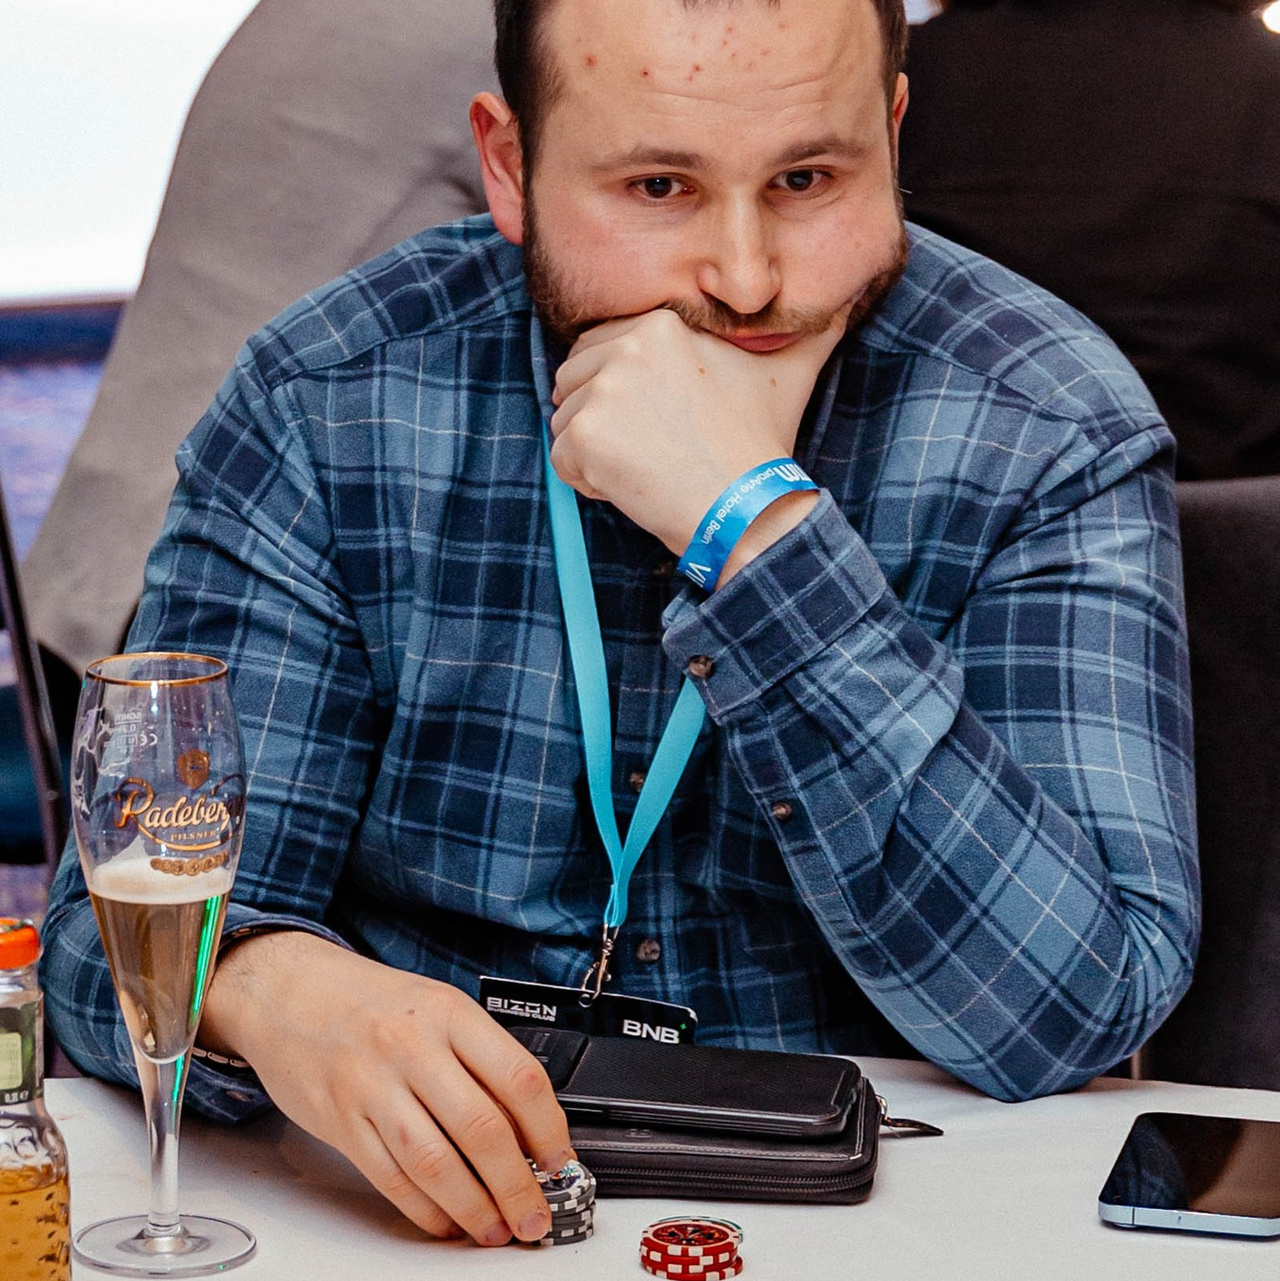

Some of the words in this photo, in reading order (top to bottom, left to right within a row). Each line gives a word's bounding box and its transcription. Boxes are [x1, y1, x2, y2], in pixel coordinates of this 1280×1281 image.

[715, 491, 744, 523] Hotel
[701, 519, 721, 545] Berlin
[487, 996, 557, 1016] BIZON
[532, 1013, 556, 1022] CLUB
[623, 1019, 680, 1044] BNB
